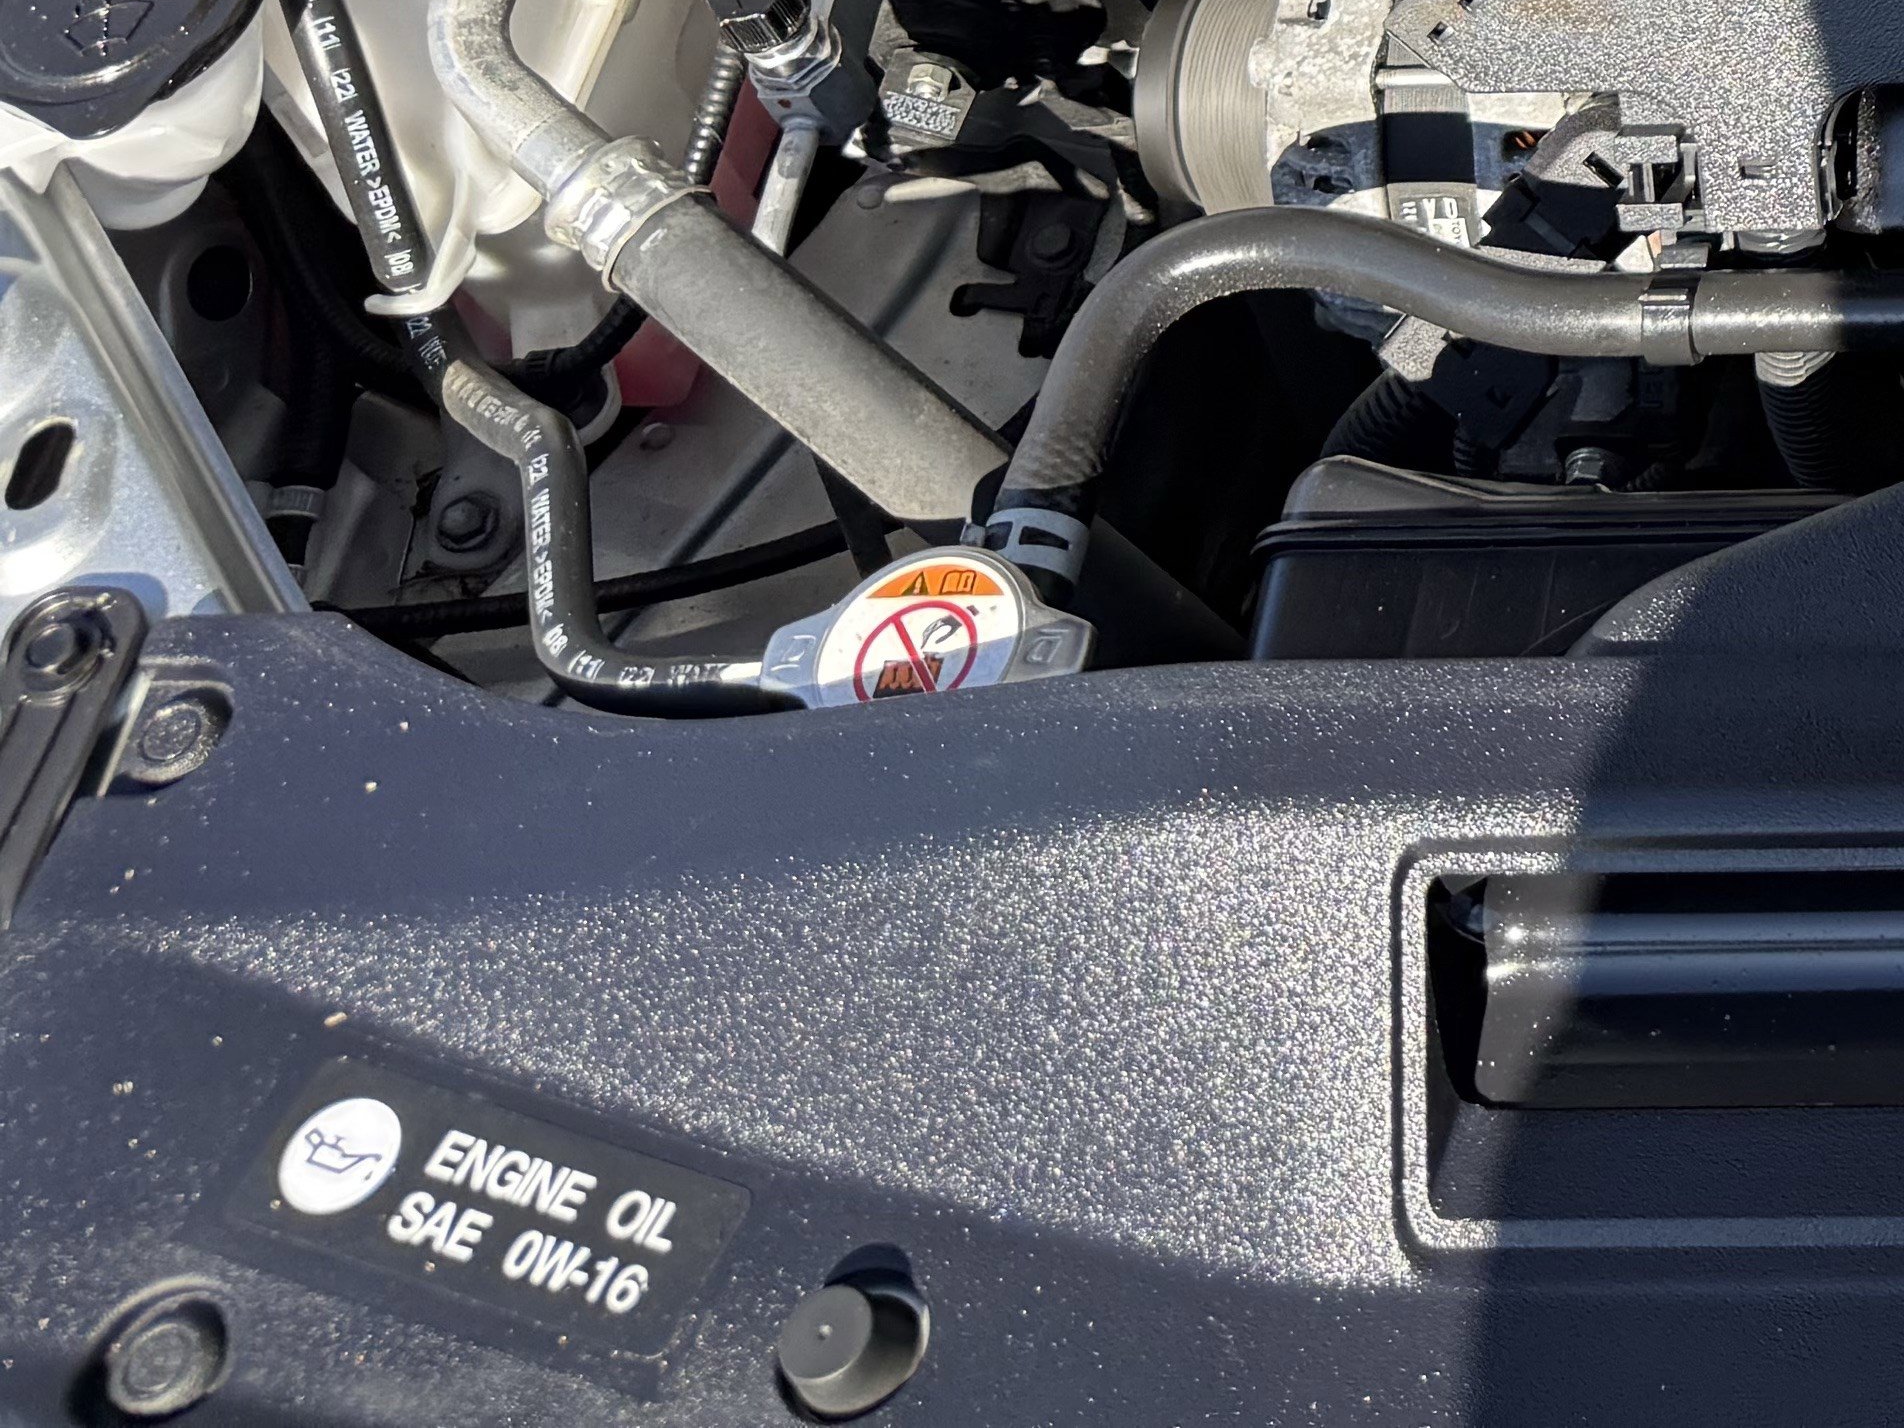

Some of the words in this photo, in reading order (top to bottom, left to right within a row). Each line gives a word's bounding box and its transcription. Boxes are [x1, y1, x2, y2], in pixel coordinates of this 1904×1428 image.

[344, 108, 380, 177] WATER
[387, 1190, 494, 1263] SAE
[502, 1229, 650, 1314] 0W-16
[423, 1129, 598, 1224] ENGINE
[606, 1189, 677, 1253] OIL
